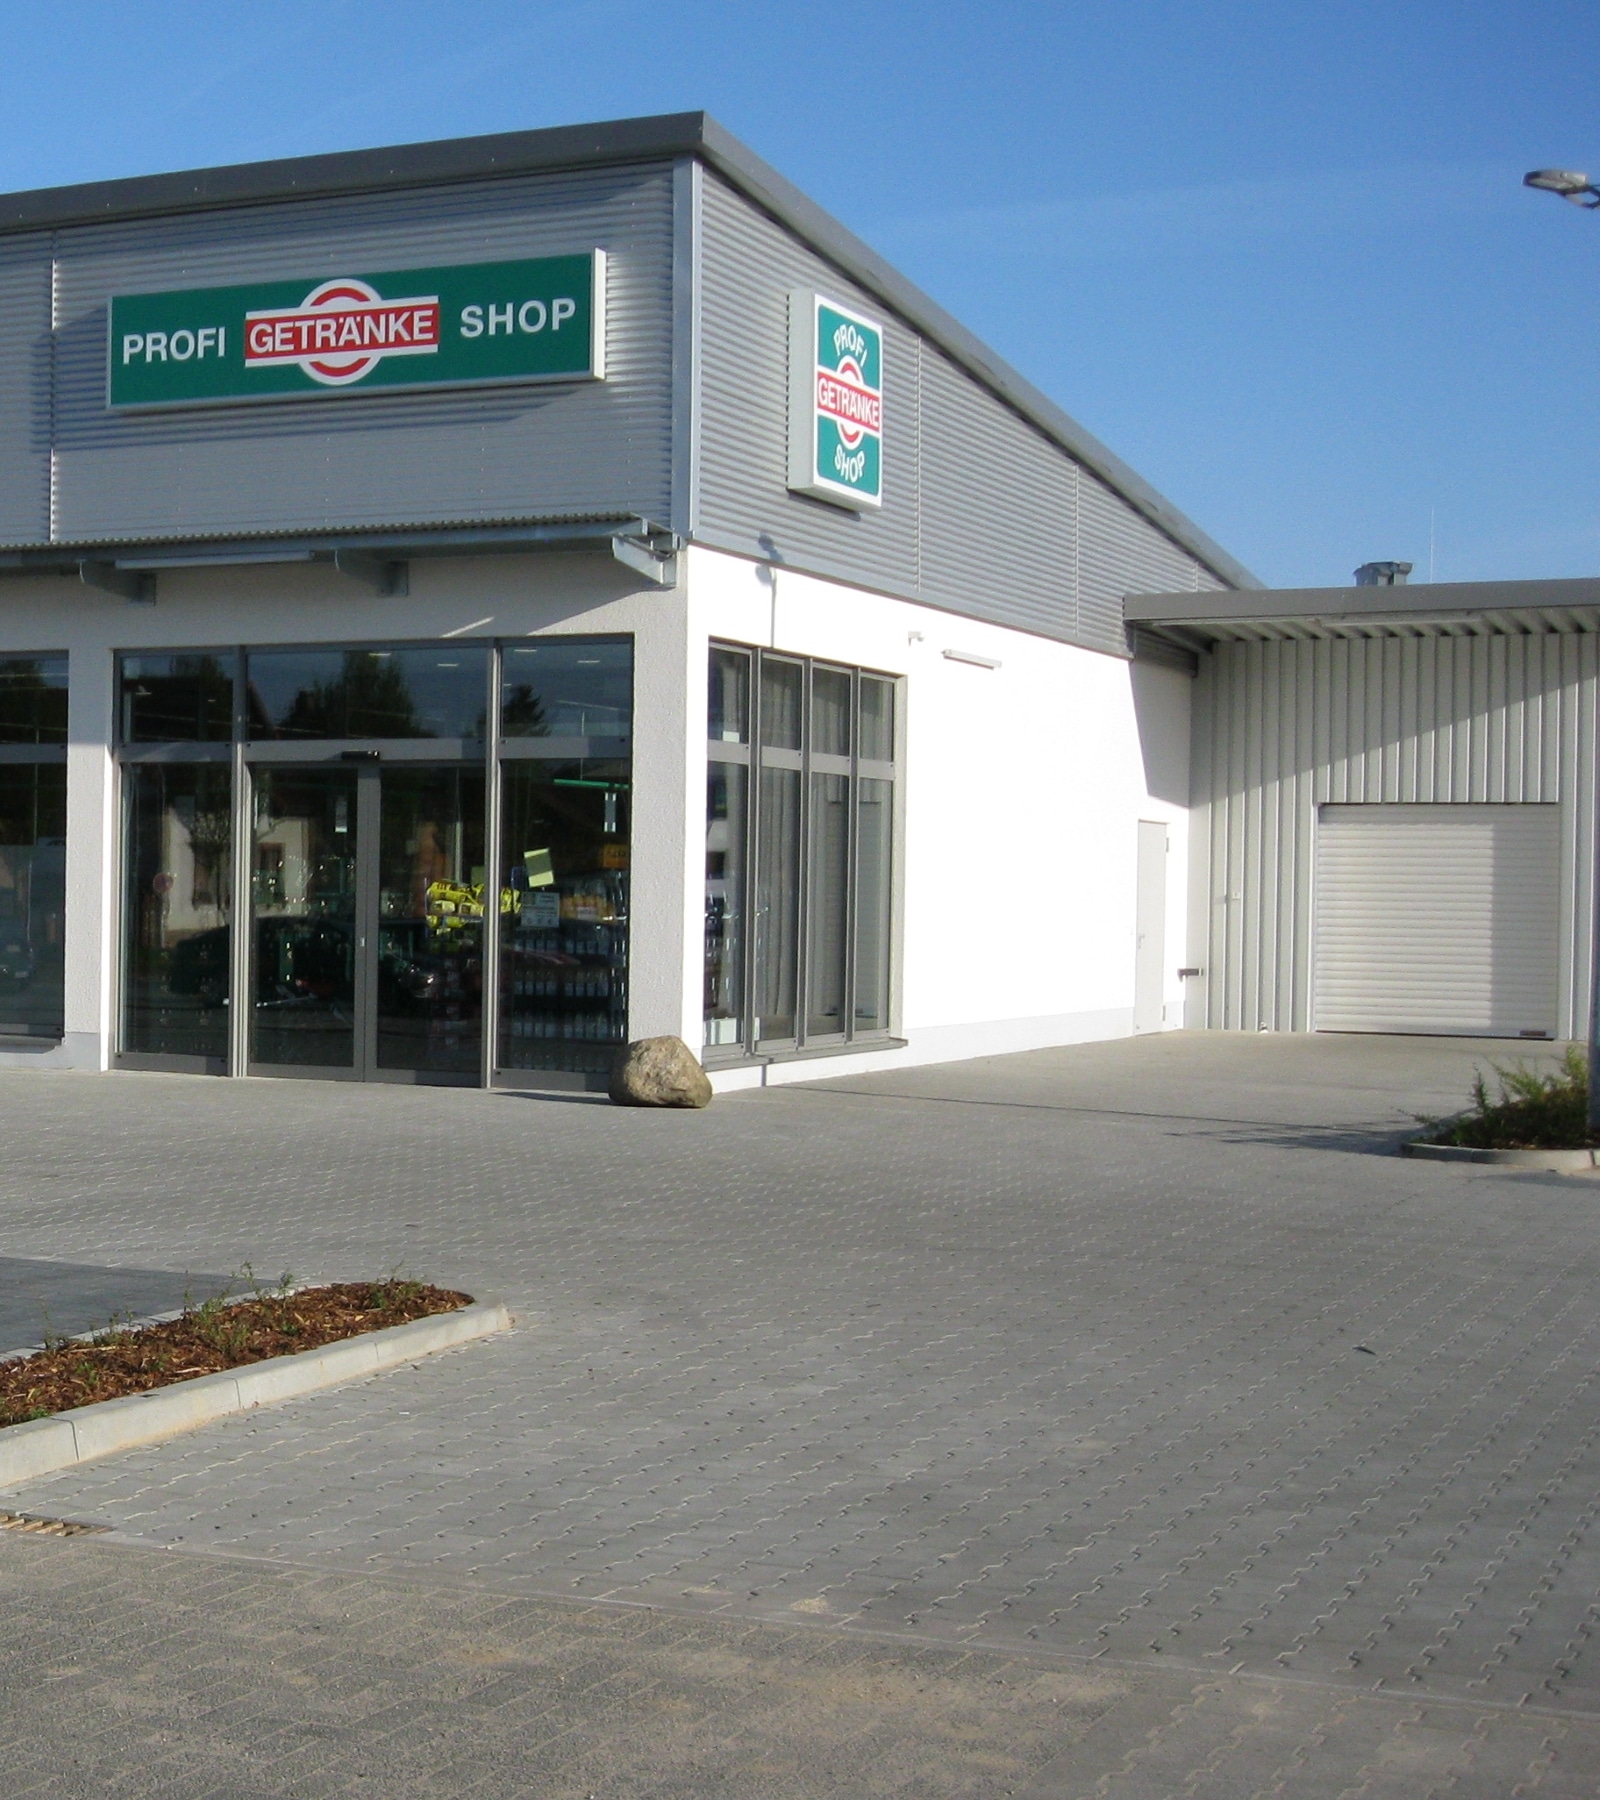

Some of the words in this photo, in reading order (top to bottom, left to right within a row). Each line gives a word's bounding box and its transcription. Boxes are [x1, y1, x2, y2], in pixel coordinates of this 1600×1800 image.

[122, 327, 226, 365] PROFI
[249, 309, 434, 355] GETRÄNKE
[459, 298, 576, 340] SHOP
[833, 324, 867, 368] PROFI
[818, 377, 879, 428] GETRÄNKE
[834, 444, 865, 483] SHOP
